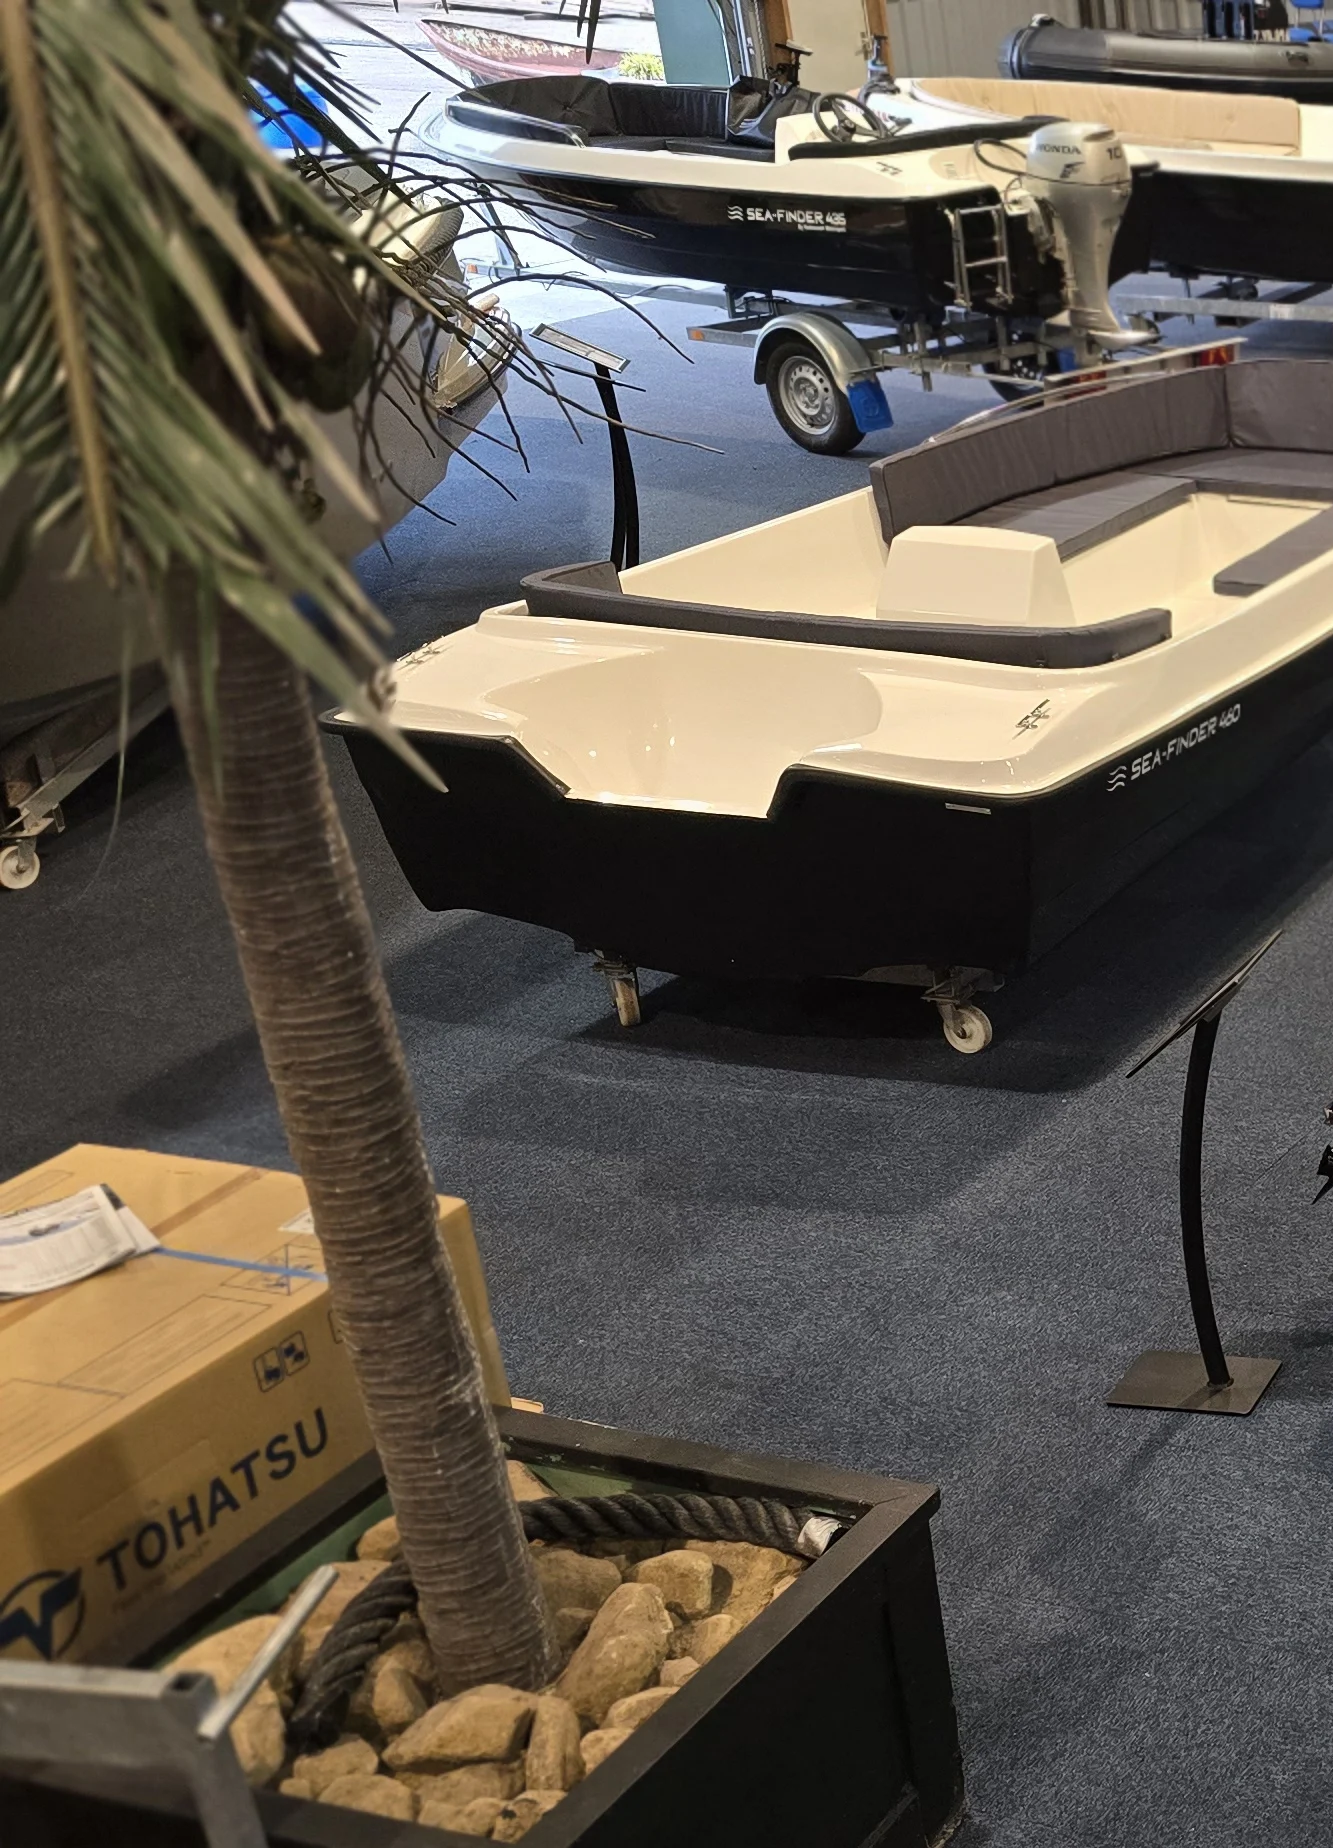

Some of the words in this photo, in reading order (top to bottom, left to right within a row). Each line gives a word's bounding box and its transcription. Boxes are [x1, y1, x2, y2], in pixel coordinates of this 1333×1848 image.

[746, 207, 824, 225] SEA-FINDER
[825, 211, 847, 226] 435
[1131, 716, 1218, 780] SEA-FINDER
[1219, 702, 1241, 729] 460
[96, 1406, 328, 1591] TOHATSU
